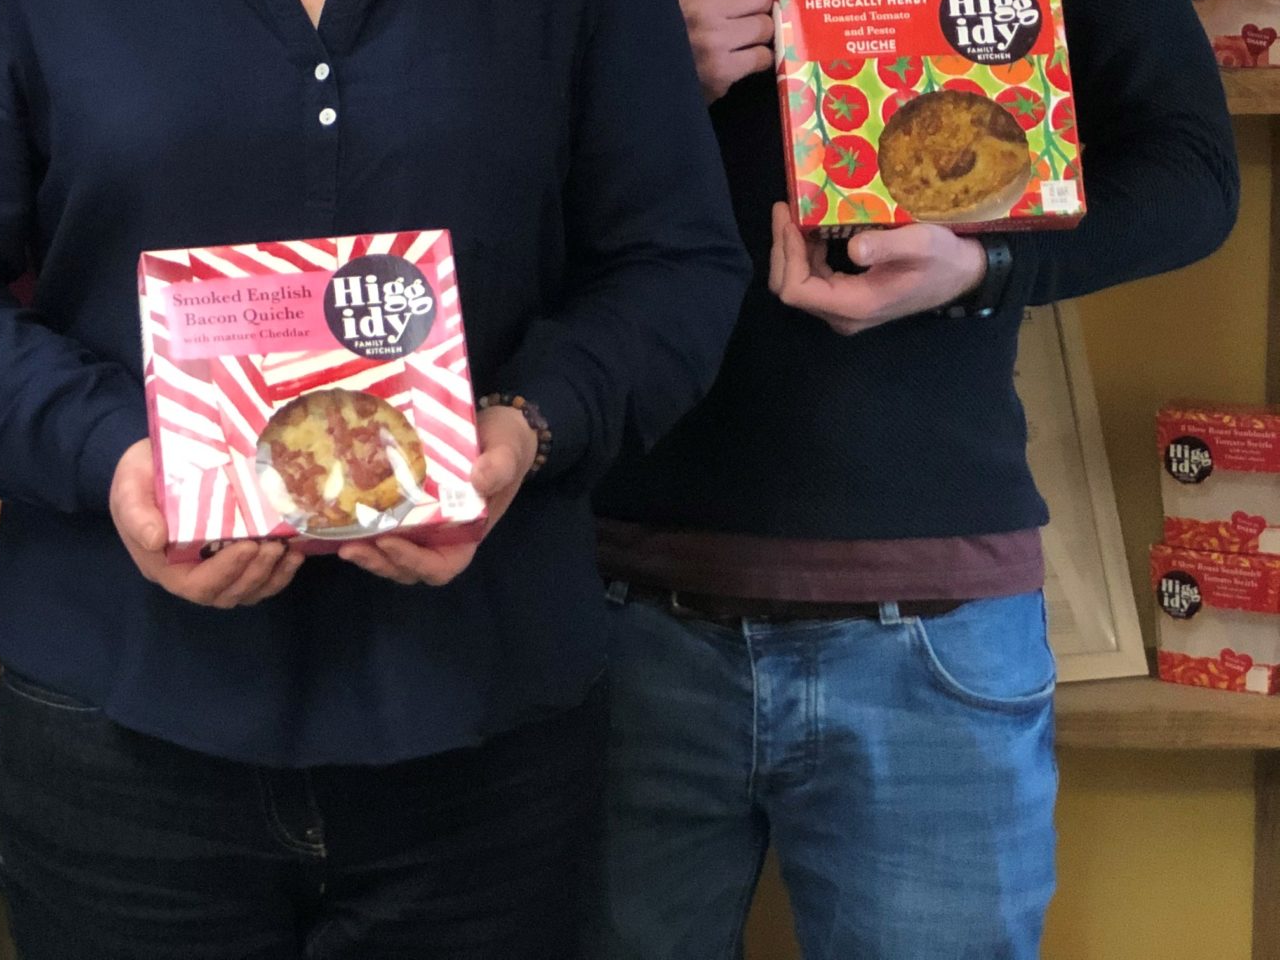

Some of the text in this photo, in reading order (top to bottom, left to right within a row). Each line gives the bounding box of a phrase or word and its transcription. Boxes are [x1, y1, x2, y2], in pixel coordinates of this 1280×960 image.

[824, 10, 910, 24] Roasted Tomato
[844, 25, 896, 37] and Pesto
[956, 15, 1020, 50] idy
[846, 38, 896, 53] QUICHE
[967, 46, 994, 54] FAMILY
[978, 52, 1011, 60] KITCHEN
[172, 285, 312, 308] Smoked English
[332, 274, 433, 314] Higg
[185, 307, 305, 327] Bacon Quiche
[342, 306, 412, 344] idy
[184, 328, 310, 344] with mature Cheddar
[354, 339, 384, 348] FAMILY
[366, 346, 402, 356] KITCHEN
[1170, 444, 1212, 467] Higg
[1172, 455, 1202, 475] idy
